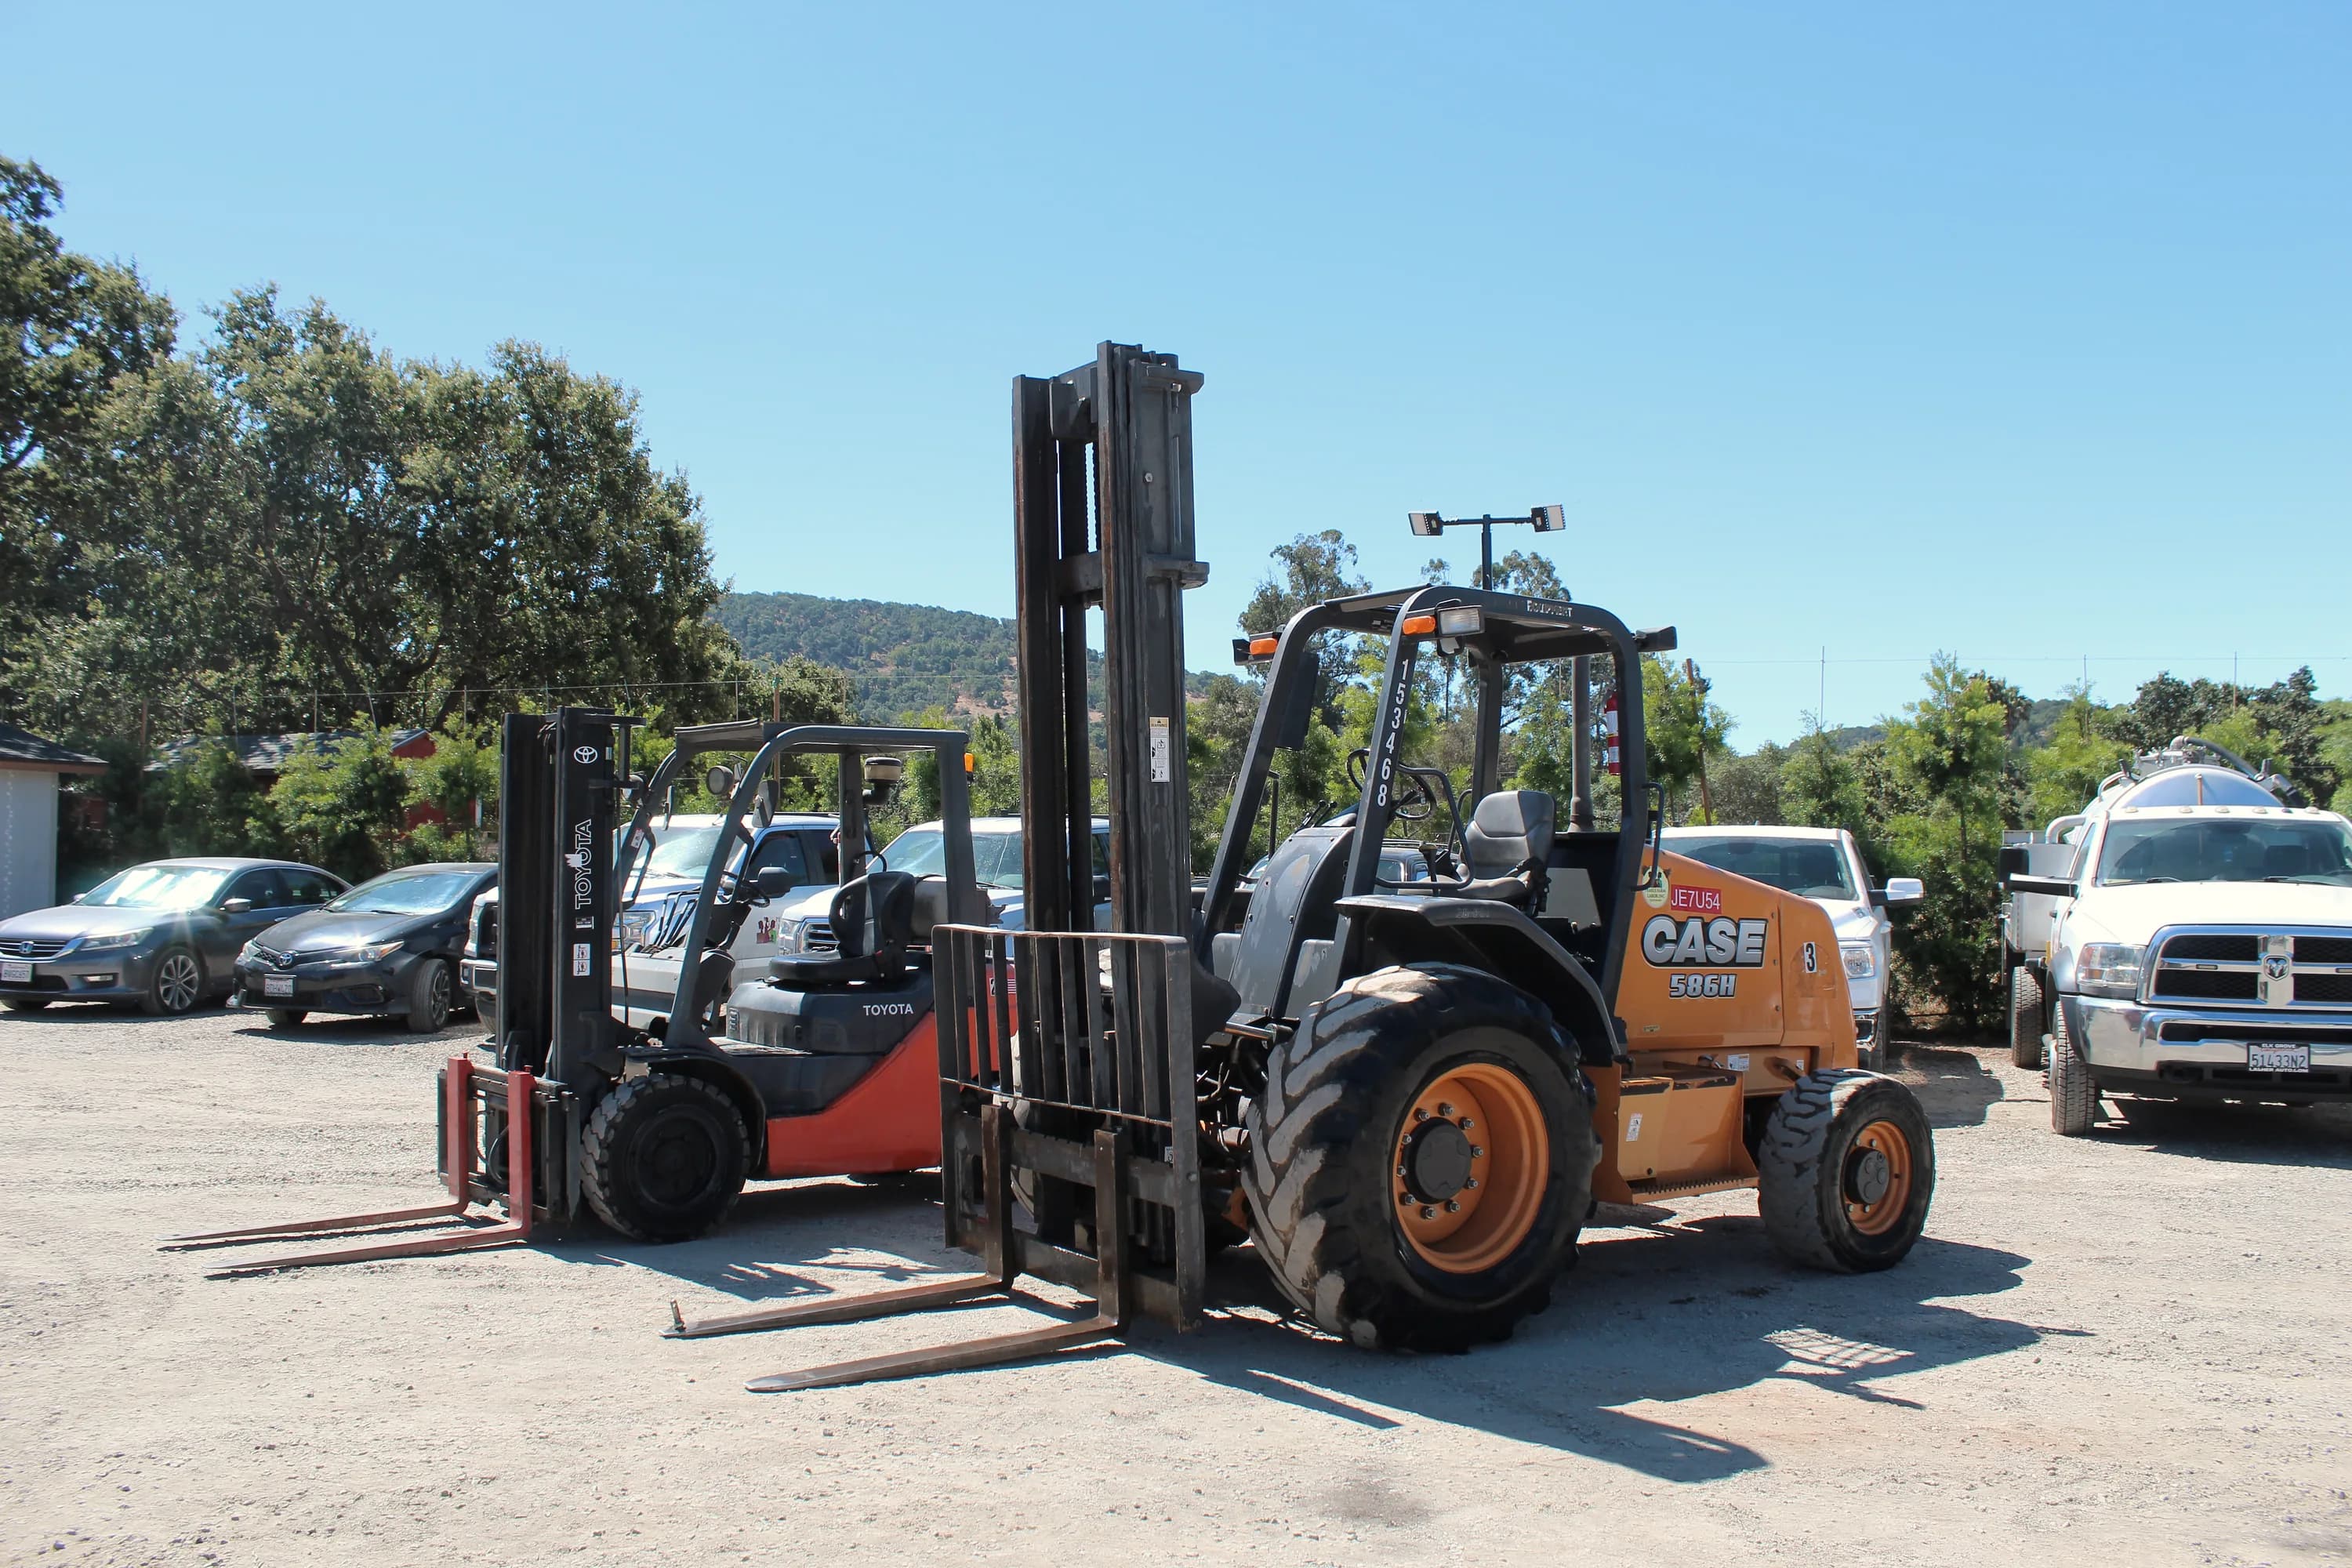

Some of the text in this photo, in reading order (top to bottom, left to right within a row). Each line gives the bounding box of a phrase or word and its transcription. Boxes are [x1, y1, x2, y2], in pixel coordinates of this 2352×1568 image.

[1377, 659, 1409, 807] 153468
[575, 818, 592, 910] TOYOTA
[1671, 888, 1721, 910] JE7U54
[1642, 915, 1768, 965] CASE
[1806, 942, 1816, 972] 3
[1669, 973, 1737, 998] 586H
[862, 1003, 914, 1016] TOYOTA
[2251, 1054, 2307, 1068] 51433N2
